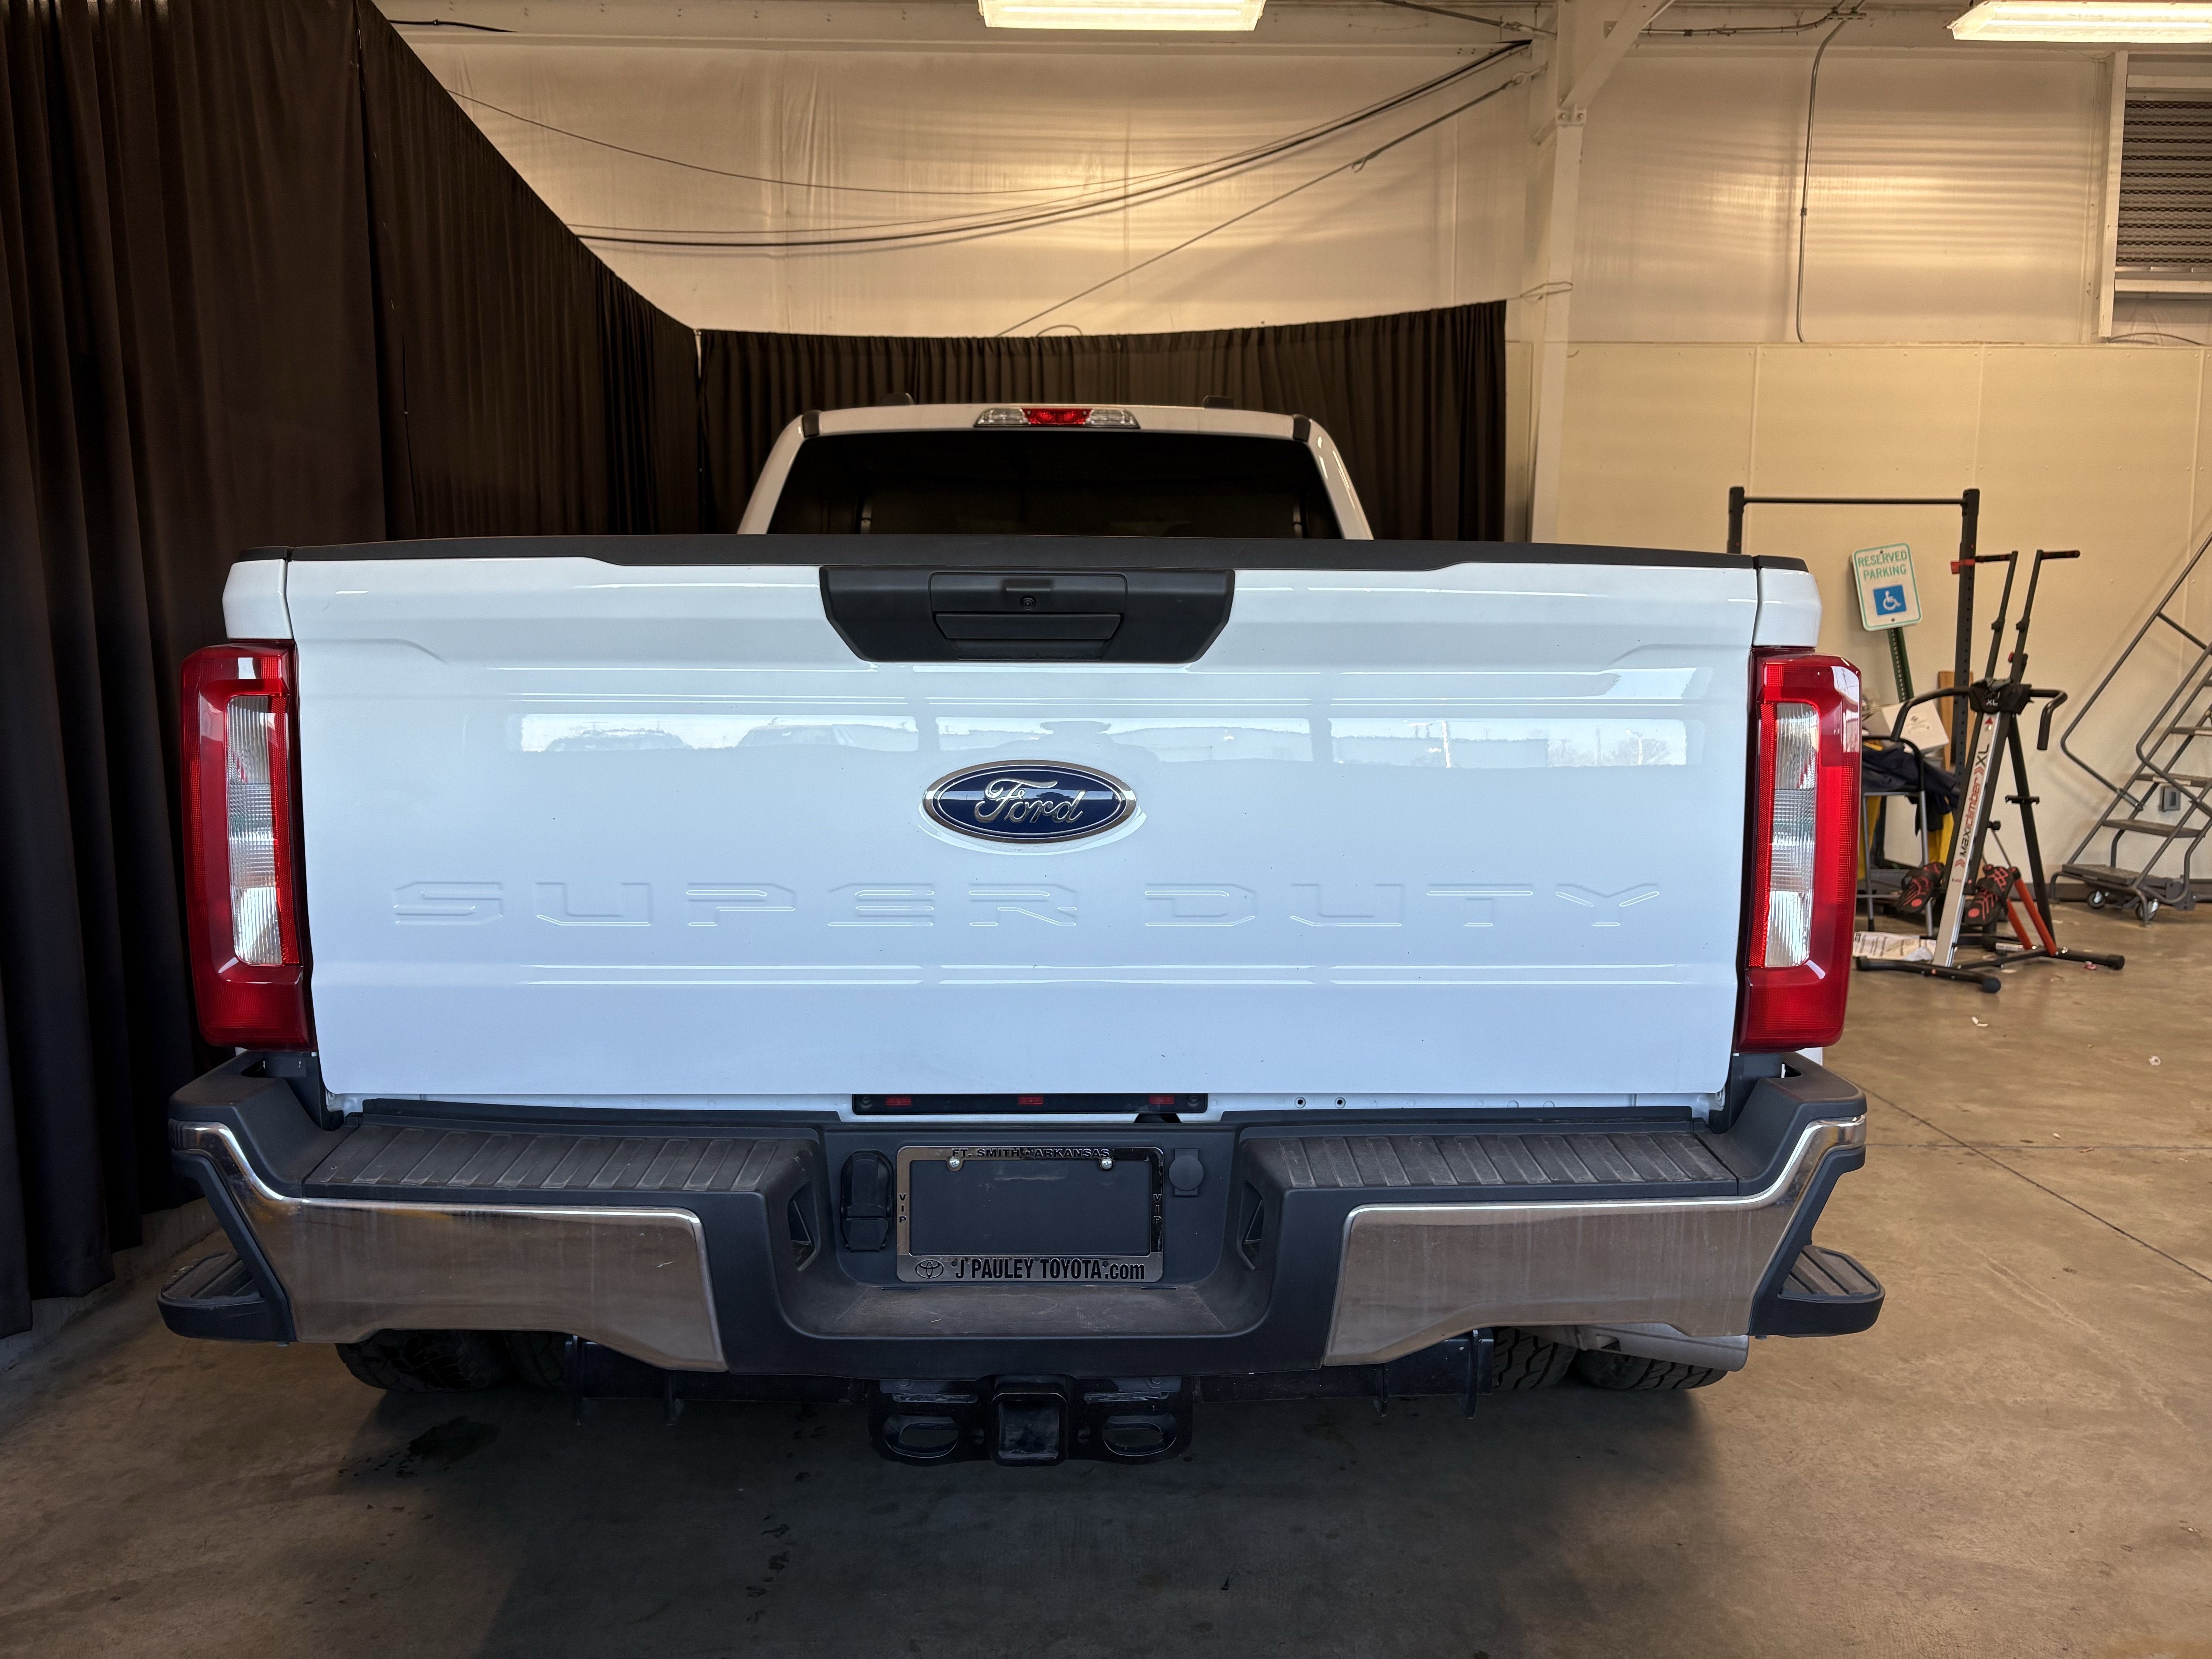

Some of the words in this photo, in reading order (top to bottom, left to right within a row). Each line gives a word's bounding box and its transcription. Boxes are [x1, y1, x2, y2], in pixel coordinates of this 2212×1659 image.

[1858, 550, 1907, 567] RESERVED
[1863, 563, 1906, 580] PARKING
[1975, 744, 1990, 768] XL
[974, 777, 1087, 824] Ford
[391, 880, 1077, 926] SUPER
[1144, 882, 1660, 927] DUTY
[952, 1148, 972, 1157] FT.
[977, 1148, 1020, 1157] SMITH
[1033, 1148, 1109, 1158] ARKANSAS
[899, 1193, 907, 1223] VIP
[1153, 1194, 1162, 1224] VIP
[955, 1258, 965, 1279] J
[971, 1258, 1035, 1278] PAULEY
